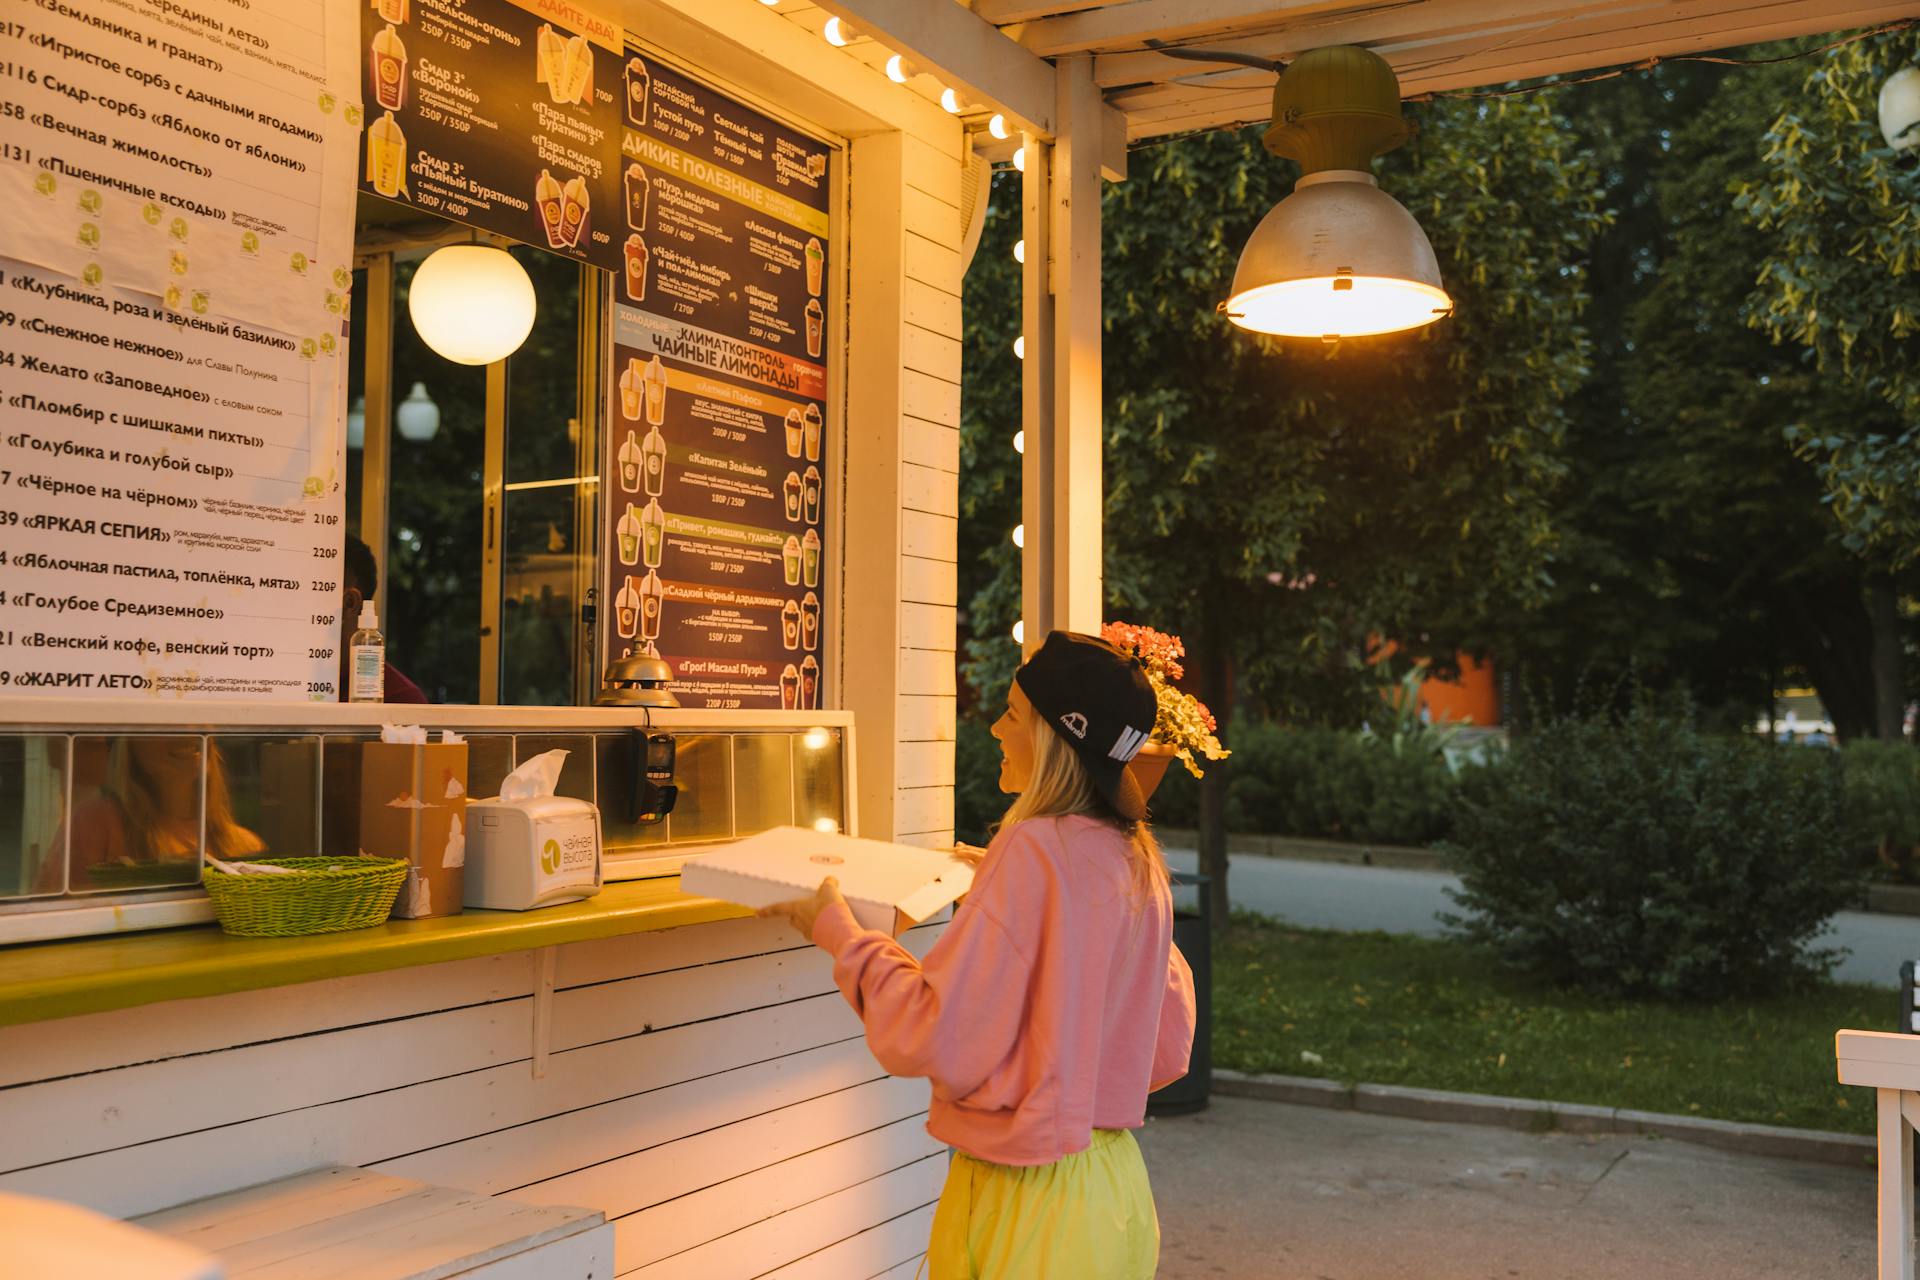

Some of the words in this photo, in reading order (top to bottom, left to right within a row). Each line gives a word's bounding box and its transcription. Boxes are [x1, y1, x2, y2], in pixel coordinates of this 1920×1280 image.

[228, 26, 269, 49] лета»
[418, 0, 521, 46] Апельсин-огонь»
[420, 21, 443, 38] 250₽
[450, 33, 472, 50] 350₽
[585, 18, 615, 42] ДВА!
[147, 37, 157, 49] и
[162, 42, 223, 72] гранат»
[419, 58, 451, 82] Сидр
[29, 33, 121, 73] «Игристое
[125, 66, 171, 91] сорбэ
[174, 84, 182, 95] с
[186, 88, 254, 120] дачными
[258, 113, 323, 144] ягодами»
[412, 70, 480, 104] «Вороной»
[595, 88, 613, 103] 700₽
[43, 75, 146, 119] Сидр-сорбэ
[151, 113, 221, 144] «Яблоко
[224, 137, 242, 151] от
[245, 145, 306, 172] яблони»
[420, 106, 442, 121] 250₽
[449, 117, 471, 132] 350₽
[532, 102, 566, 124] «Пара
[567, 116, 605, 139] пьяных
[538, 115, 587, 143] Буратин»
[653, 102, 683, 124] Густой
[684, 119, 705, 136] пуэр
[713, 113, 748, 138] Светлый
[30, 113, 107, 146] «Вечная
[112, 138, 212, 178] жимолость»
[531, 135, 565, 155] «Пара
[567, 149, 602, 170] сидров
[713, 130, 747, 154] Тёмный
[418, 151, 450, 174] Сидр
[538, 147, 591, 177] Вороных»
[622, 132, 680, 171] ДИКИЕ
[682, 157, 762, 205] ПОЛЕЗНЫЕ
[38, 157, 156, 200] «Пшеничные
[160, 192, 226, 221] всходы»
[410, 163, 467, 190] «Пьяный
[469, 180, 529, 211] Буратино»
[417, 192, 440, 207] 300₽
[447, 202, 469, 216] 400₽
[652, 177, 683, 198] «Пуэр,
[592, 231, 610, 244] 600₽
[11, 276, 109, 311] «Клубника,
[113, 299, 149, 318] роза
[153, 308, 163, 321] и
[232, 325, 296, 351] базилик»
[20, 318, 109, 346] «Снежное
[114, 337, 184, 362] нежное»
[187, 356, 202, 367] для
[205, 358, 233, 372] Славы
[235, 364, 278, 382] Полунина
[652, 333, 717, 366] ЧАЙНЫЕ
[719, 354, 800, 391] ЛИМОНАДЫ
[680, 327, 784, 369] КЛИМАТКОНТРОЛЬ
[20, 354, 88, 380] Желато
[93, 371, 210, 403] «Заповедное»
[214, 397, 219, 406] с
[221, 399, 254, 412] еловым
[256, 405, 283, 417] соком
[8, 394, 104, 424] «Пломбир
[109, 412, 118, 423] с
[123, 414, 204, 438] шишками
[208, 428, 264, 448] пихты»
[7, 433, 104, 460] «Голубика
[110, 450, 120, 462] и
[125, 452, 190, 472] голубой
[195, 463, 234, 480] сыр»
[688, 452, 728, 470] «Капитан
[17, 474, 96, 496] «Чёрное
[101, 487, 121, 499] на
[126, 488, 198, 509] чёрном»
[314, 513, 338, 525] 210₽
[23, 514, 95, 534] «ЯРКАЯ
[100, 522, 171, 542] СЕПИЯ»
[313, 547, 338, 559] 220₽
[12, 553, 108, 574] «Яблочная
[113, 563, 179, 582] пастила,
[183, 570, 255, 589] топлёнка,
[259, 577, 300, 590] мята»
[312, 581, 337, 592] 220₽
[12, 592, 99, 613] «Голубое
[104, 598, 224, 620] Средиземное»
[311, 615, 335, 625] 190₽
[21, 633, 108, 650] «Венский
[114, 638, 161, 656] кофе,
[165, 641, 229, 656] венский
[233, 646, 274, 660] торт»
[309, 648, 333, 659] 200₽
[14, 671, 94, 688] «ЖАРИТ
[97, 674, 153, 689] ЛЕТО»
[679, 661, 706, 675] «Грог!
[707, 662, 739, 674] Масала!
[563, 834, 592, 850] чайная
[563, 850, 592, 865] высота
